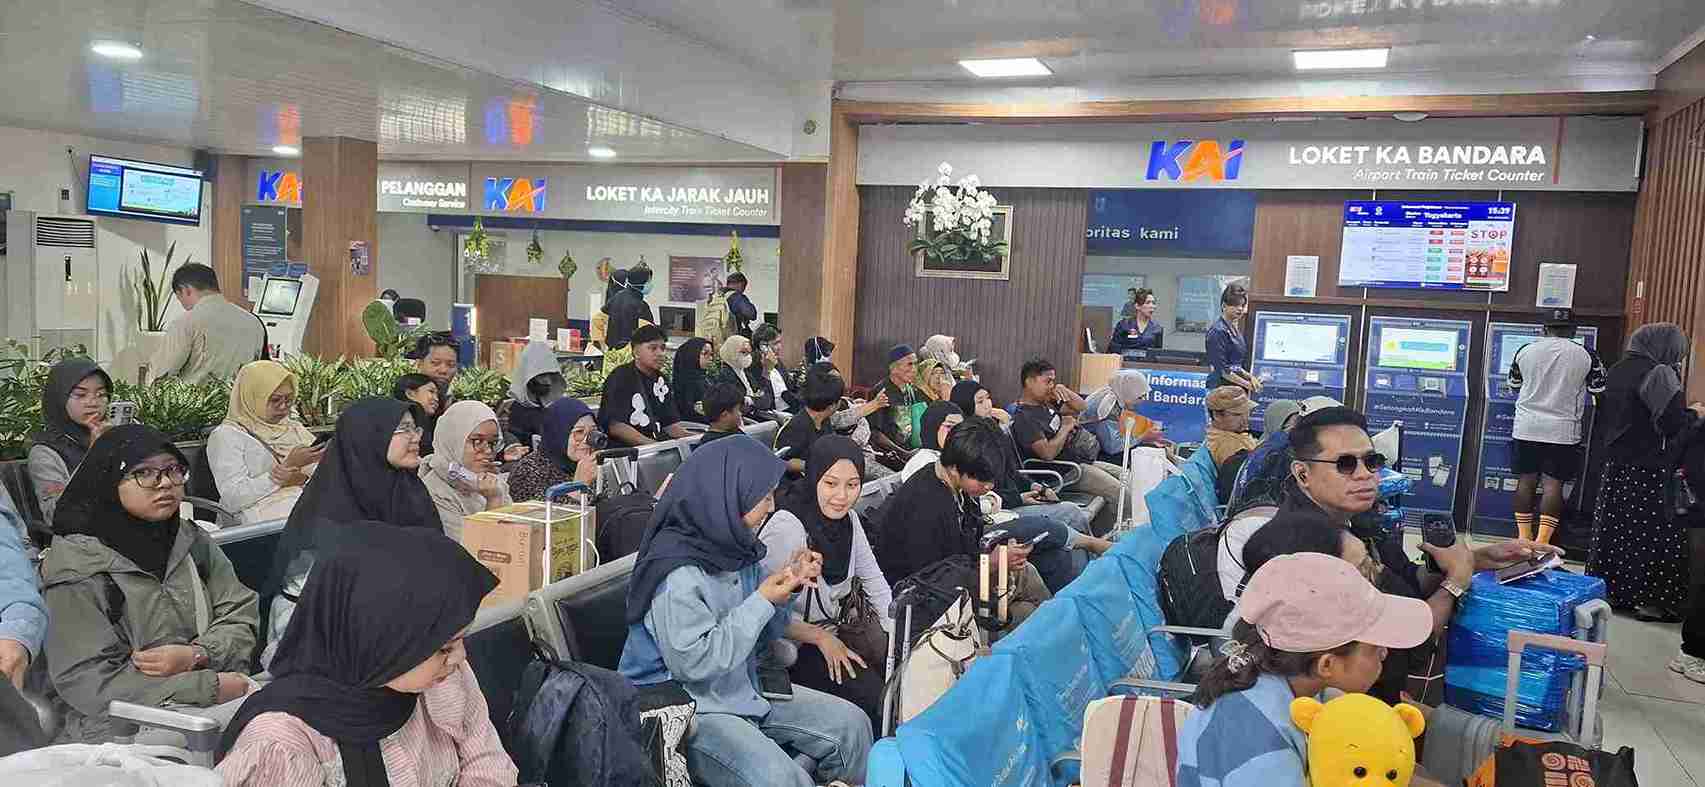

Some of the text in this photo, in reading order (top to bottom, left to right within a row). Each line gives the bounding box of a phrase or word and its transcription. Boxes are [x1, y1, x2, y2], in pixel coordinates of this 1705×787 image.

[1145, 139, 1246, 182] KAI
[1289, 145, 1546, 165] LOKET KA BANDARA
[1353, 168, 1545, 182] Airport Train Ticket Counter
[258, 170, 304, 202] KA
[381, 181, 466, 197] PELANGGAN
[483, 176, 546, 212] KAI
[586, 185, 769, 204] LOKET KA JARAK JAUH
[403, 198, 466, 208] Customer Service
[644, 206, 680, 217] Intercity
[705, 207, 731, 216] Ticket
[733, 207, 767, 217] Counter
[1086, 225, 1178, 239] oritas kami
[1147, 374, 1206, 388] Informas
